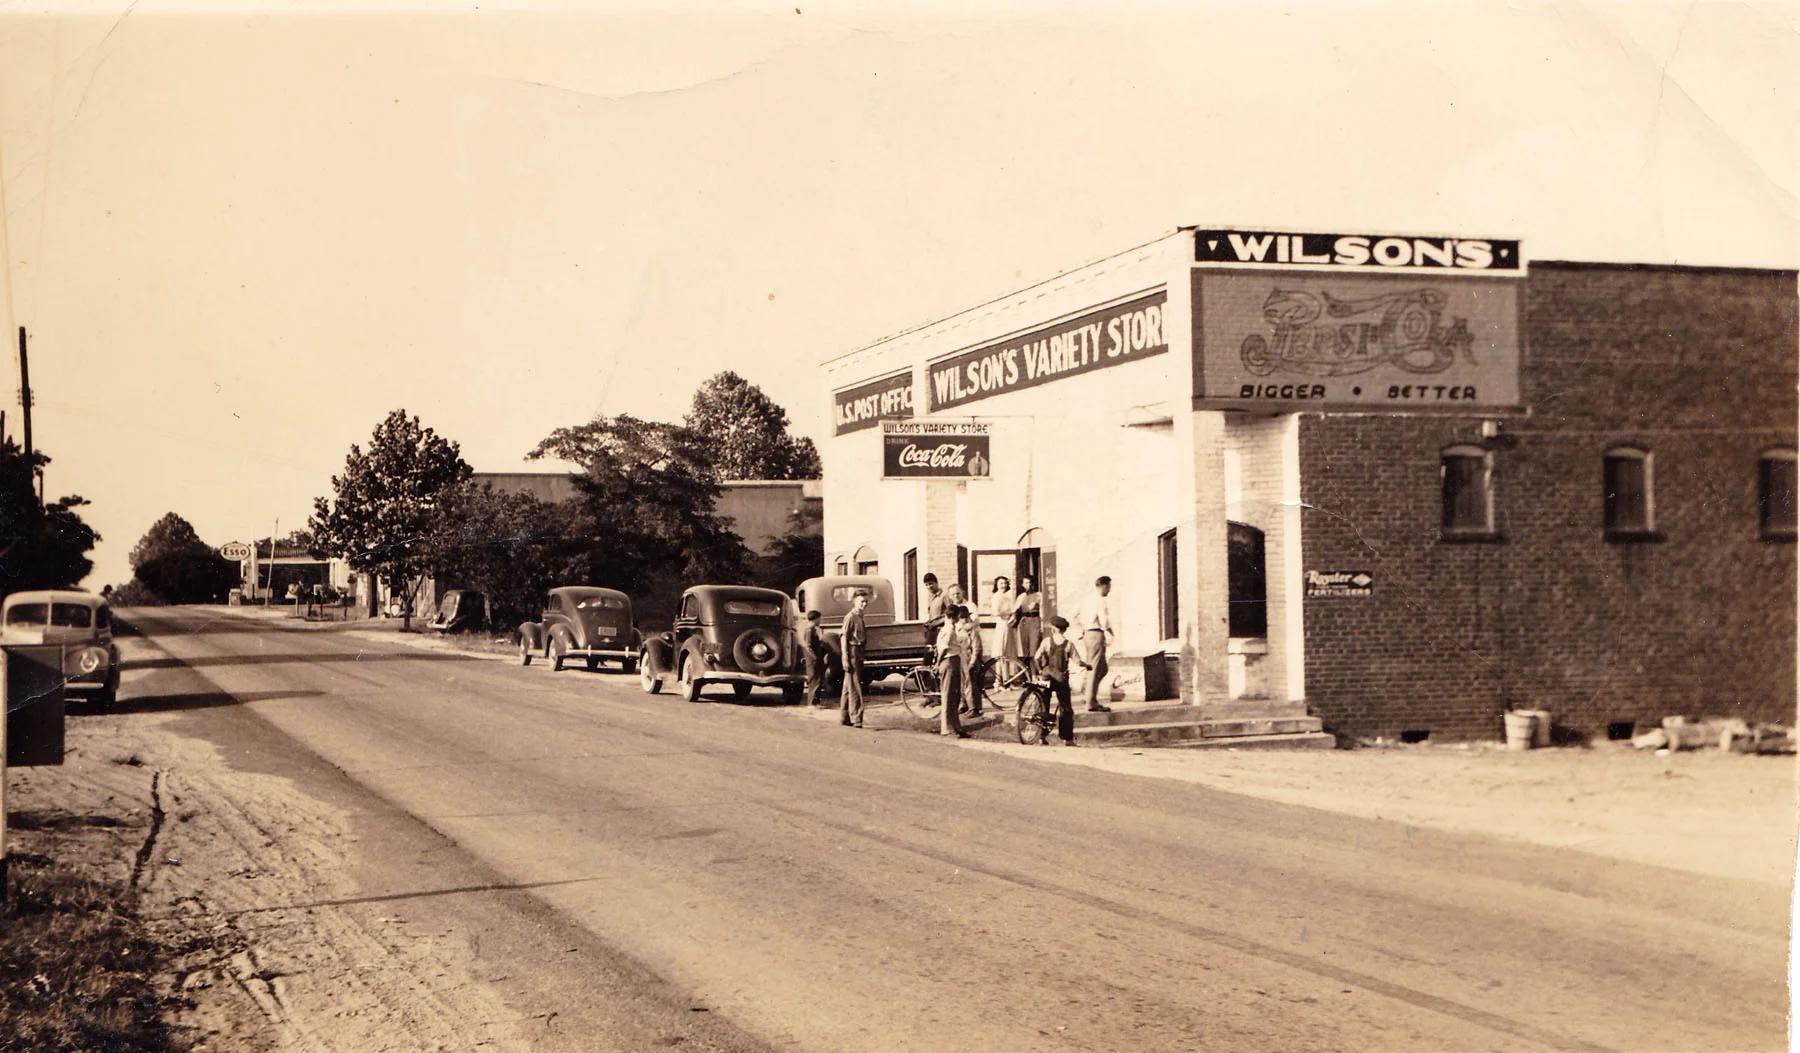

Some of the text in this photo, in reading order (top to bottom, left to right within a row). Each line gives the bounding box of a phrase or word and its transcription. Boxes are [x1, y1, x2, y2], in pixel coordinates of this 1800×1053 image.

[1228, 234, 1494, 268] WILSON'S
[933, 347, 1019, 404] WILSON'S
[1022, 321, 1103, 381] VARIETY
[854, 393, 880, 422] POST
[881, 385, 913, 416] OFFIC
[1239, 384, 1477, 400] BIGGER BETTER
[883, 423, 989, 434] WILSON'S VARIETY STORE
[899, 444, 968, 467] Coca-Cola
